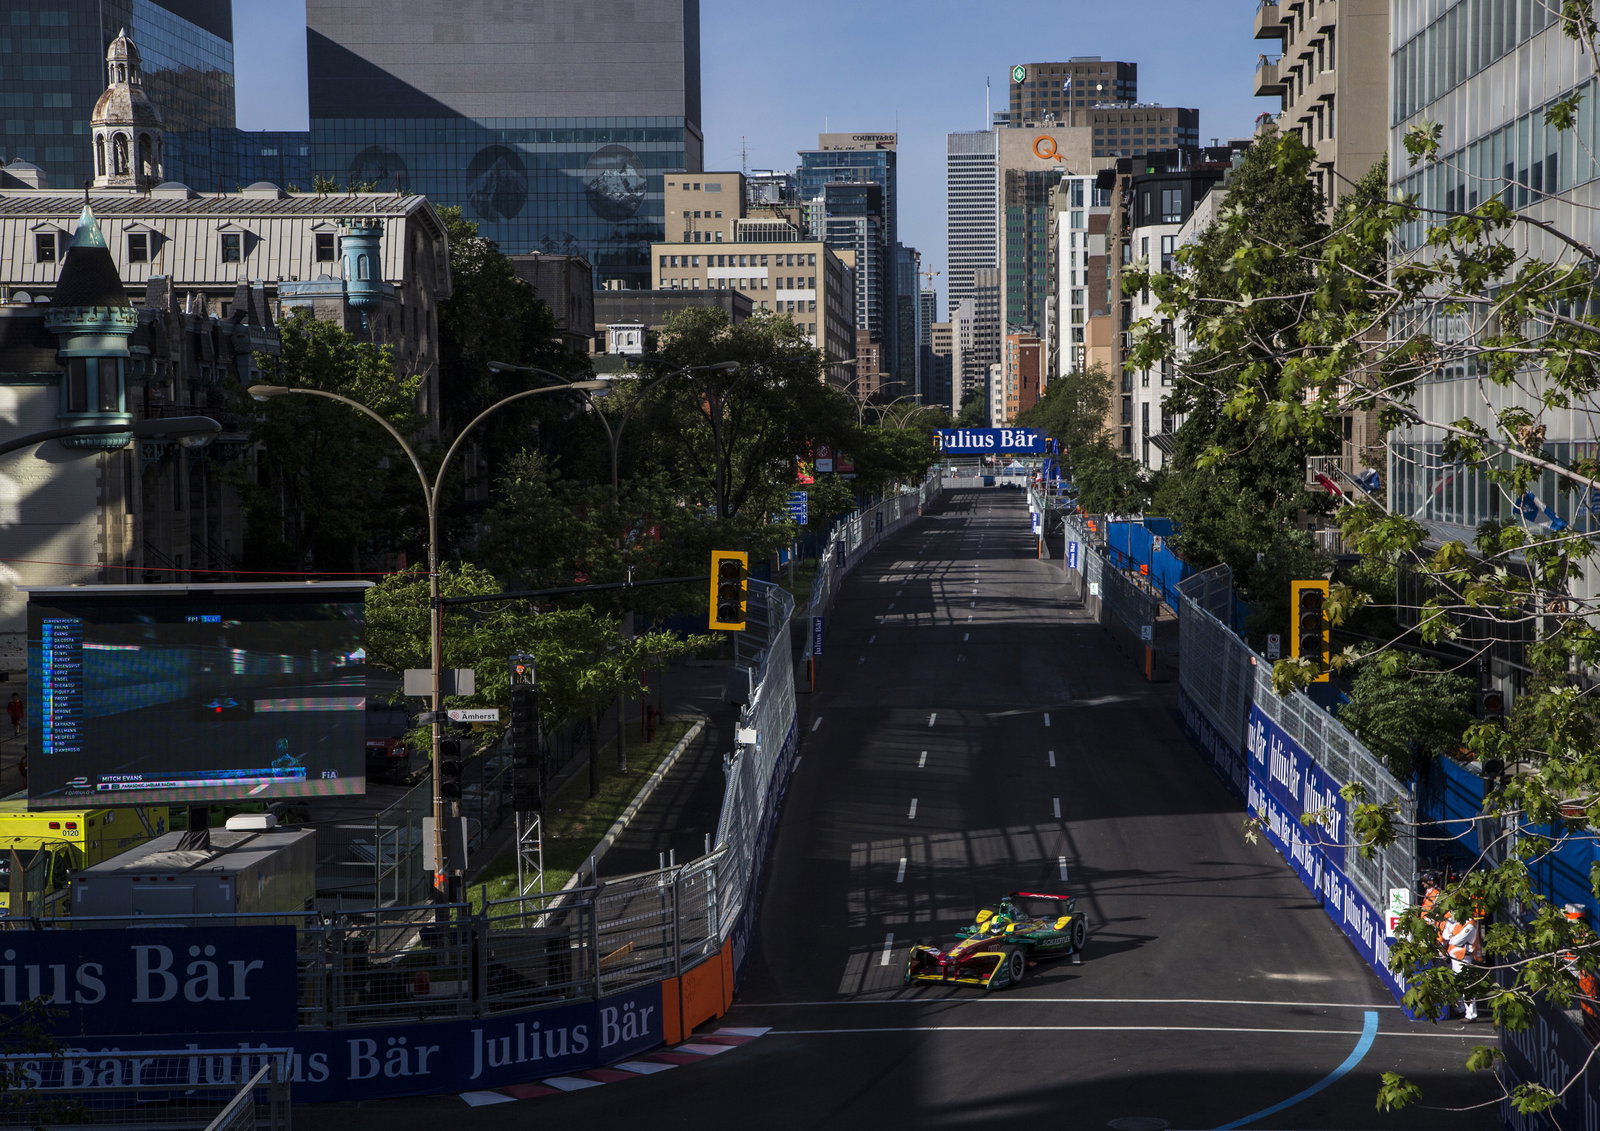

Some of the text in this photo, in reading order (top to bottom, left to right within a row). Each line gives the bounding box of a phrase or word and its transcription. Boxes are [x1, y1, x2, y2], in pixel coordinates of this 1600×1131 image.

[1000, 430, 1037, 448] Bär
[1270, 734, 1301, 801] Julius Bär
[1281, 812, 1290, 848] Bär
[1304, 839, 1314, 877] Bär
[1331, 870, 1342, 911] Bär
[1344, 884, 1361, 934] Julius
[1361, 904, 1373, 949] Bär
[130, 944, 264, 1003] Bär
[60, 1047, 154, 1088] Bär
[346, 1036, 440, 1080] Bär
[469, 1021, 589, 1080] Julius
[600, 1000, 655, 1050] Bär
